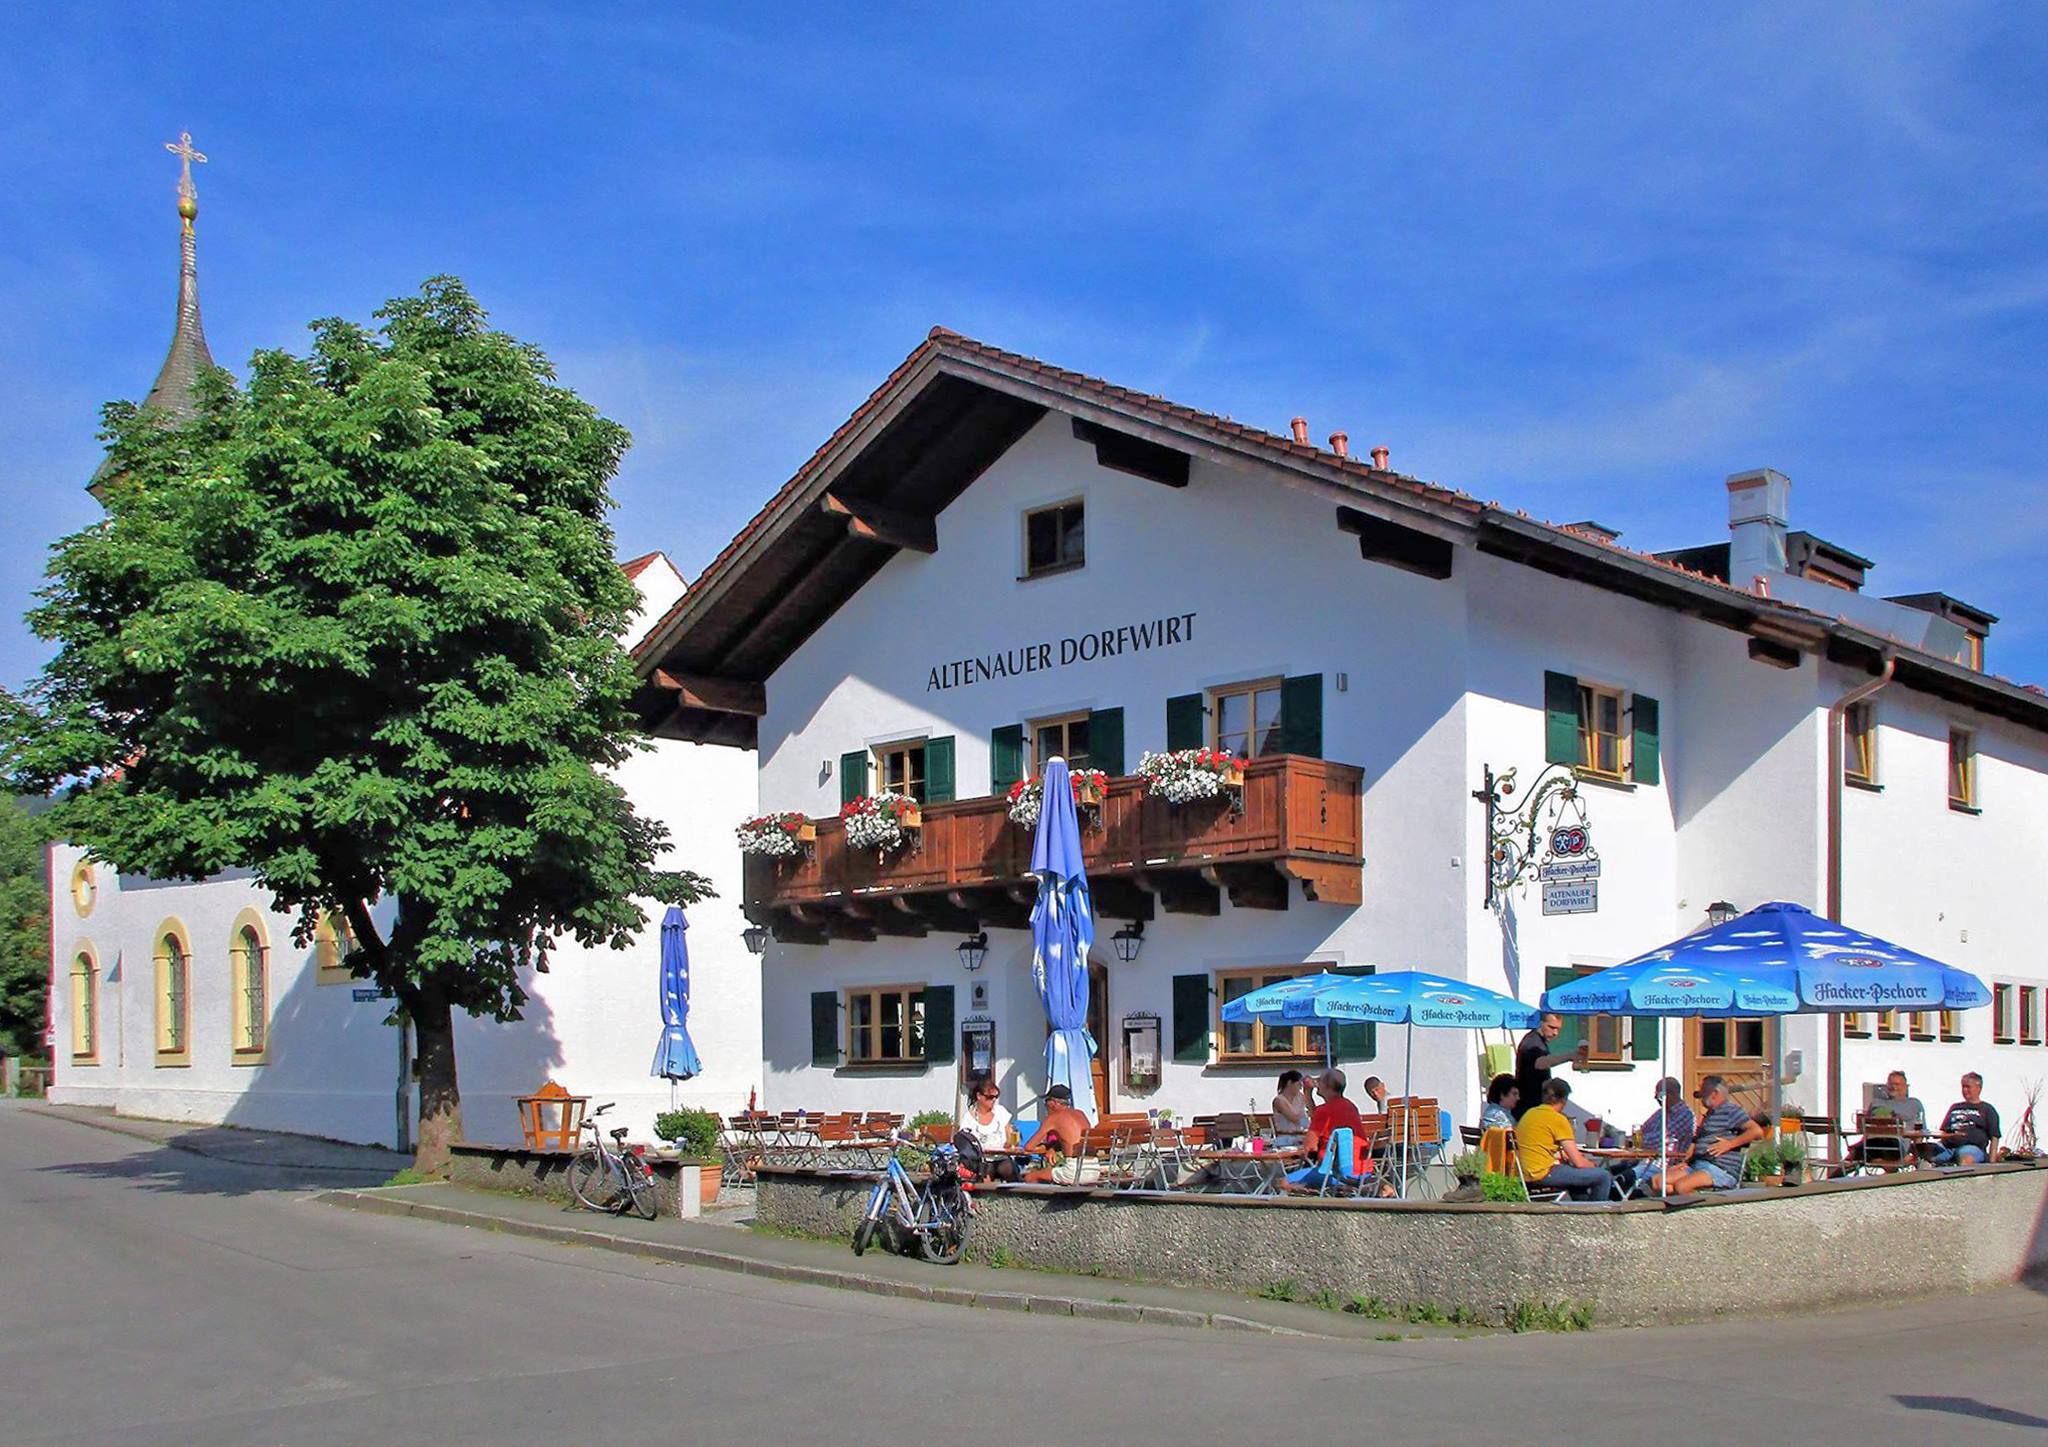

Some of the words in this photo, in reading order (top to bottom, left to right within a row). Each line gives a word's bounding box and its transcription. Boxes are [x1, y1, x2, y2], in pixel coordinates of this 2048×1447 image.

[927, 643, 1052, 692] ALTENAUER
[1060, 612, 1197, 666] DORFWIRT
[1549, 888, 1591, 899] ALTENAUER
[1550, 897, 1589, 907] DORFWIRT
[1814, 982, 1927, 1003] Hacker-Pschorr
[1255, 997, 1282, 1007] Hacker
[1644, 994, 1720, 1007] Hacker-Pschorr
[1326, 1001, 1395, 1017] Hacker-Pschorr
[1421, 1010, 1491, 1023] Hacker-Pschorr
